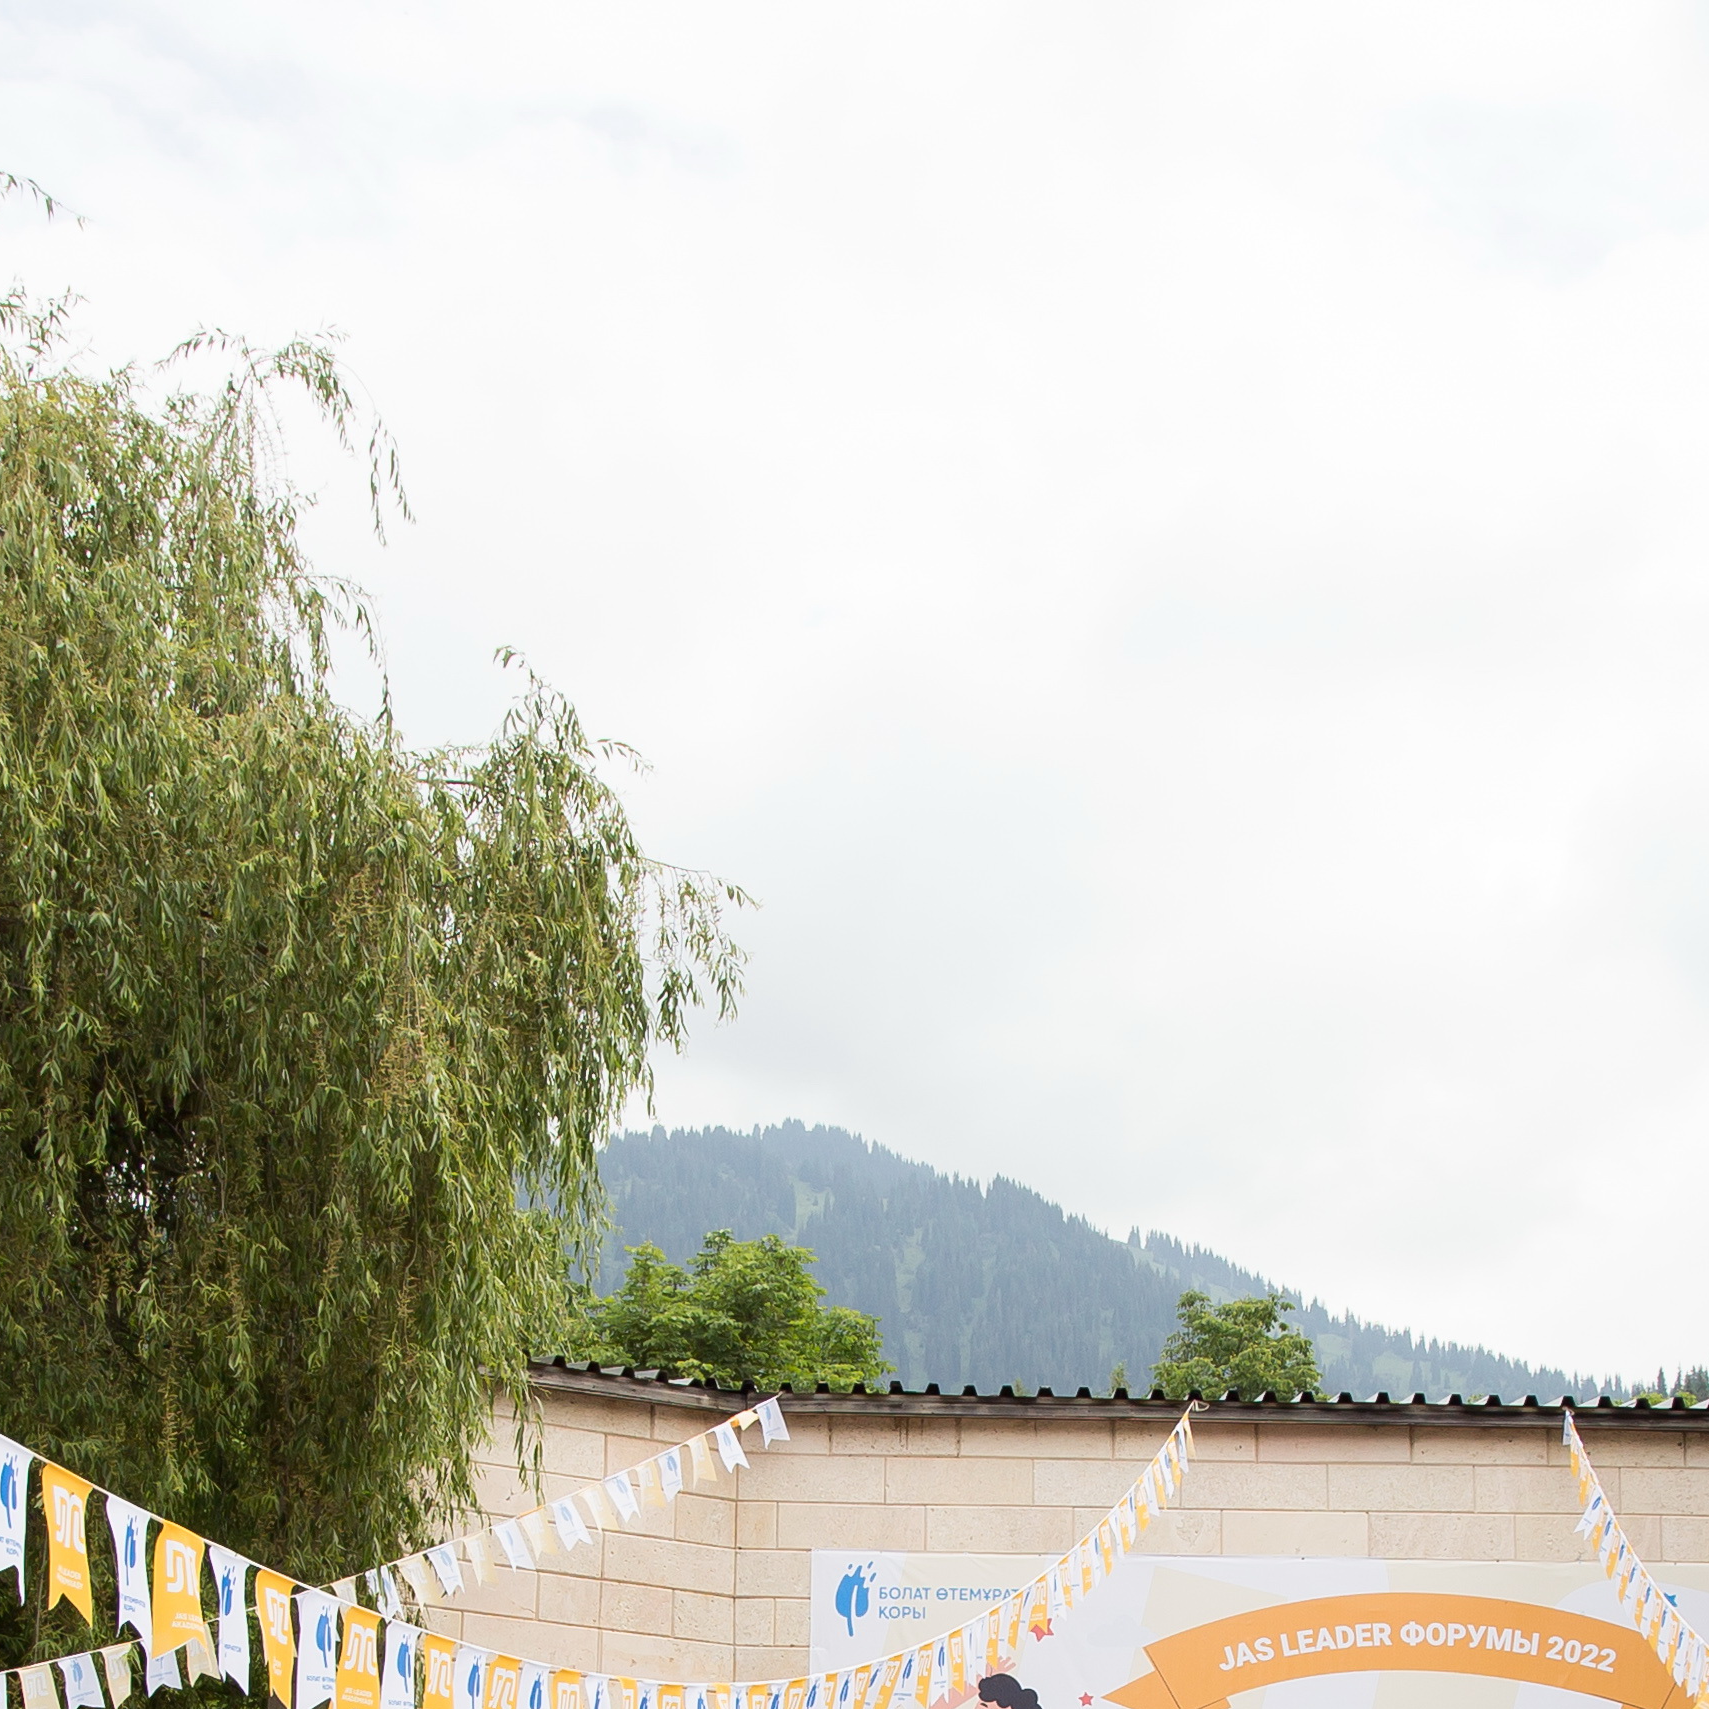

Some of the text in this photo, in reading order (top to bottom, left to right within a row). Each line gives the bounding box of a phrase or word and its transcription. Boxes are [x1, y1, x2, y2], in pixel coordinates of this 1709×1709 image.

[878, 1586, 931, 1601] БОЛАТ
[1218, 1621, 1618, 1673] JAS LEADER ФОРУМЫ 2022
